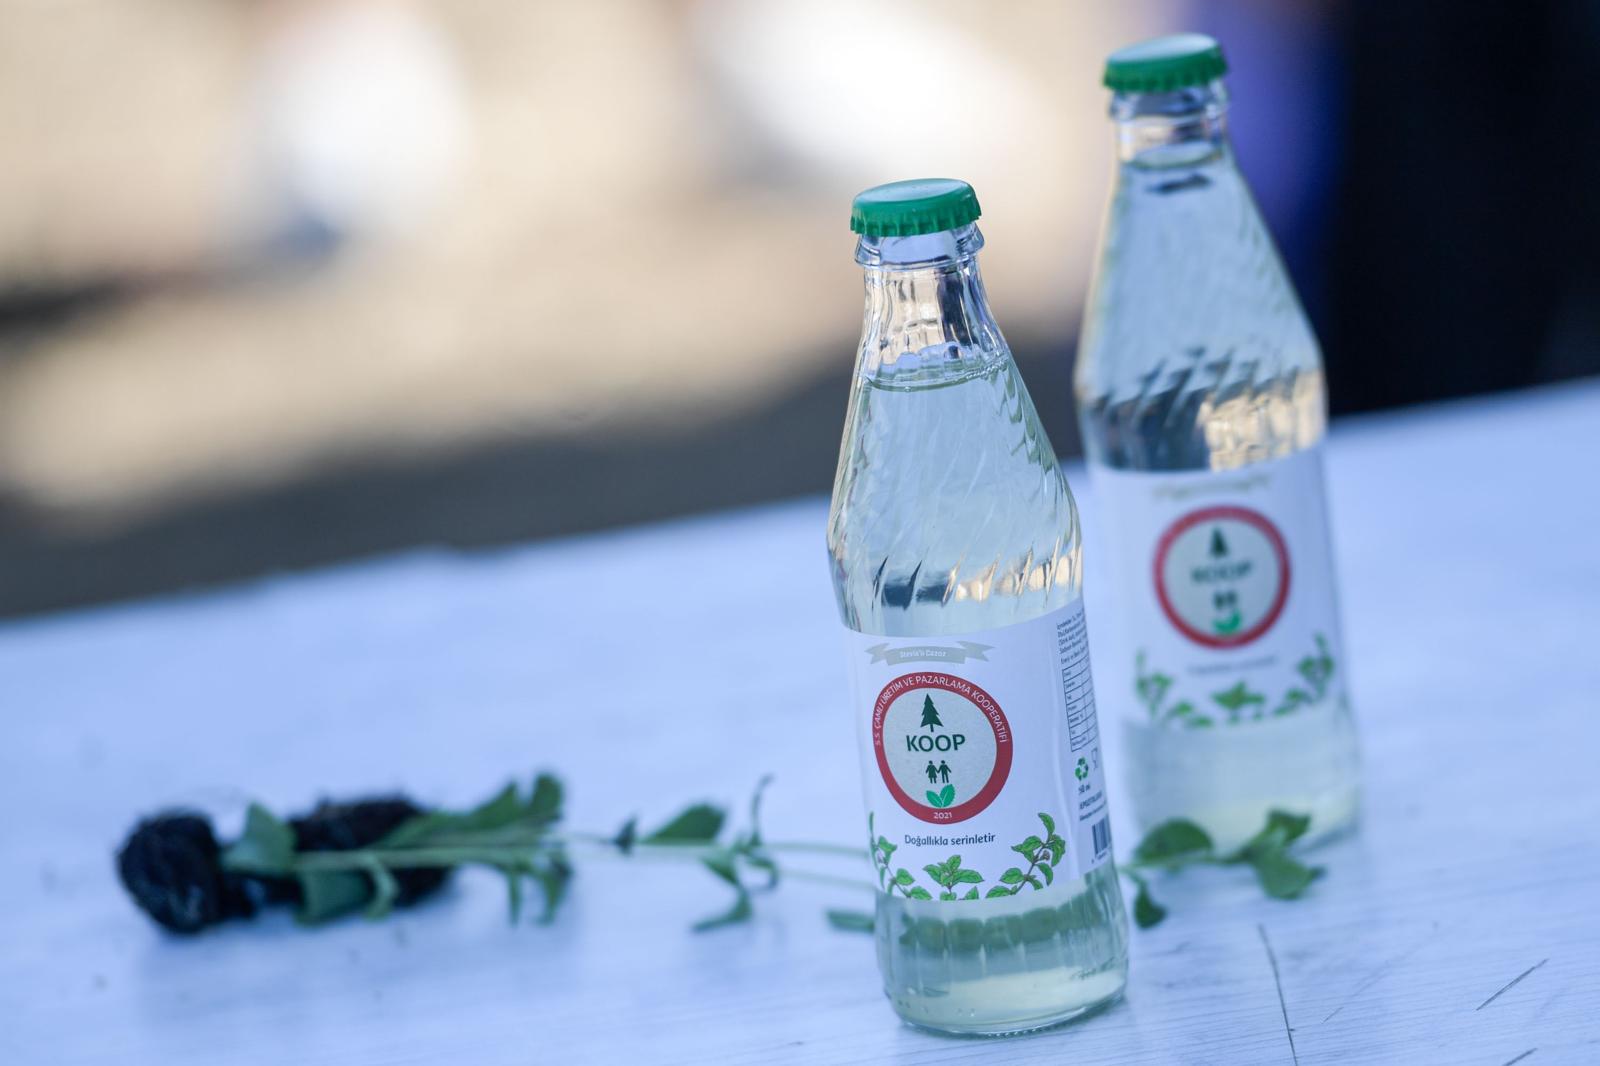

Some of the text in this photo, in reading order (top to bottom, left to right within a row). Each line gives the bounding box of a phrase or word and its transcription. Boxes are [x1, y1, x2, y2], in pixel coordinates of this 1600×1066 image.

[903, 676, 915, 687] VE
[915, 675, 972, 695] PAZARLAMA
[906, 733, 966, 752] KOOP
[933, 811, 952, 820] 2021
[904, 832, 996, 846] Doğallıkla serinletir
